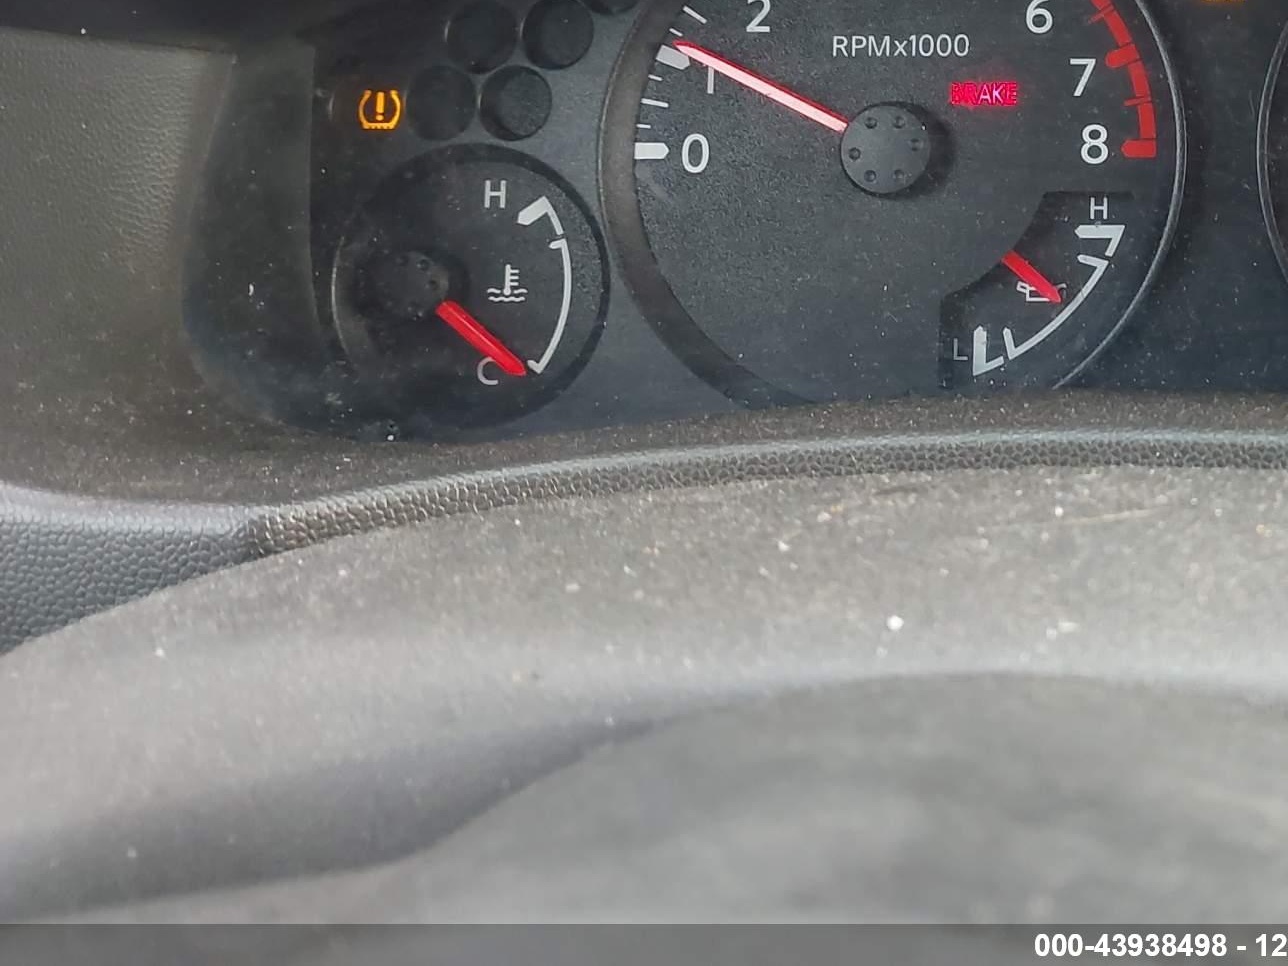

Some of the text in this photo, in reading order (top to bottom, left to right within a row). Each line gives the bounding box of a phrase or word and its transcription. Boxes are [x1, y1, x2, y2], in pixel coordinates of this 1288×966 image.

[832, 34, 970, 57] RPMx1000
[1069, 58, 1096, 97] 7
[681, 133, 710, 174] 0
[1080, 124, 1109, 165] 8
[484, 179, 507, 209] H
[1089, 197, 1108, 220] H
[953, 337, 969, 362] L
[476, 357, 501, 386] C
